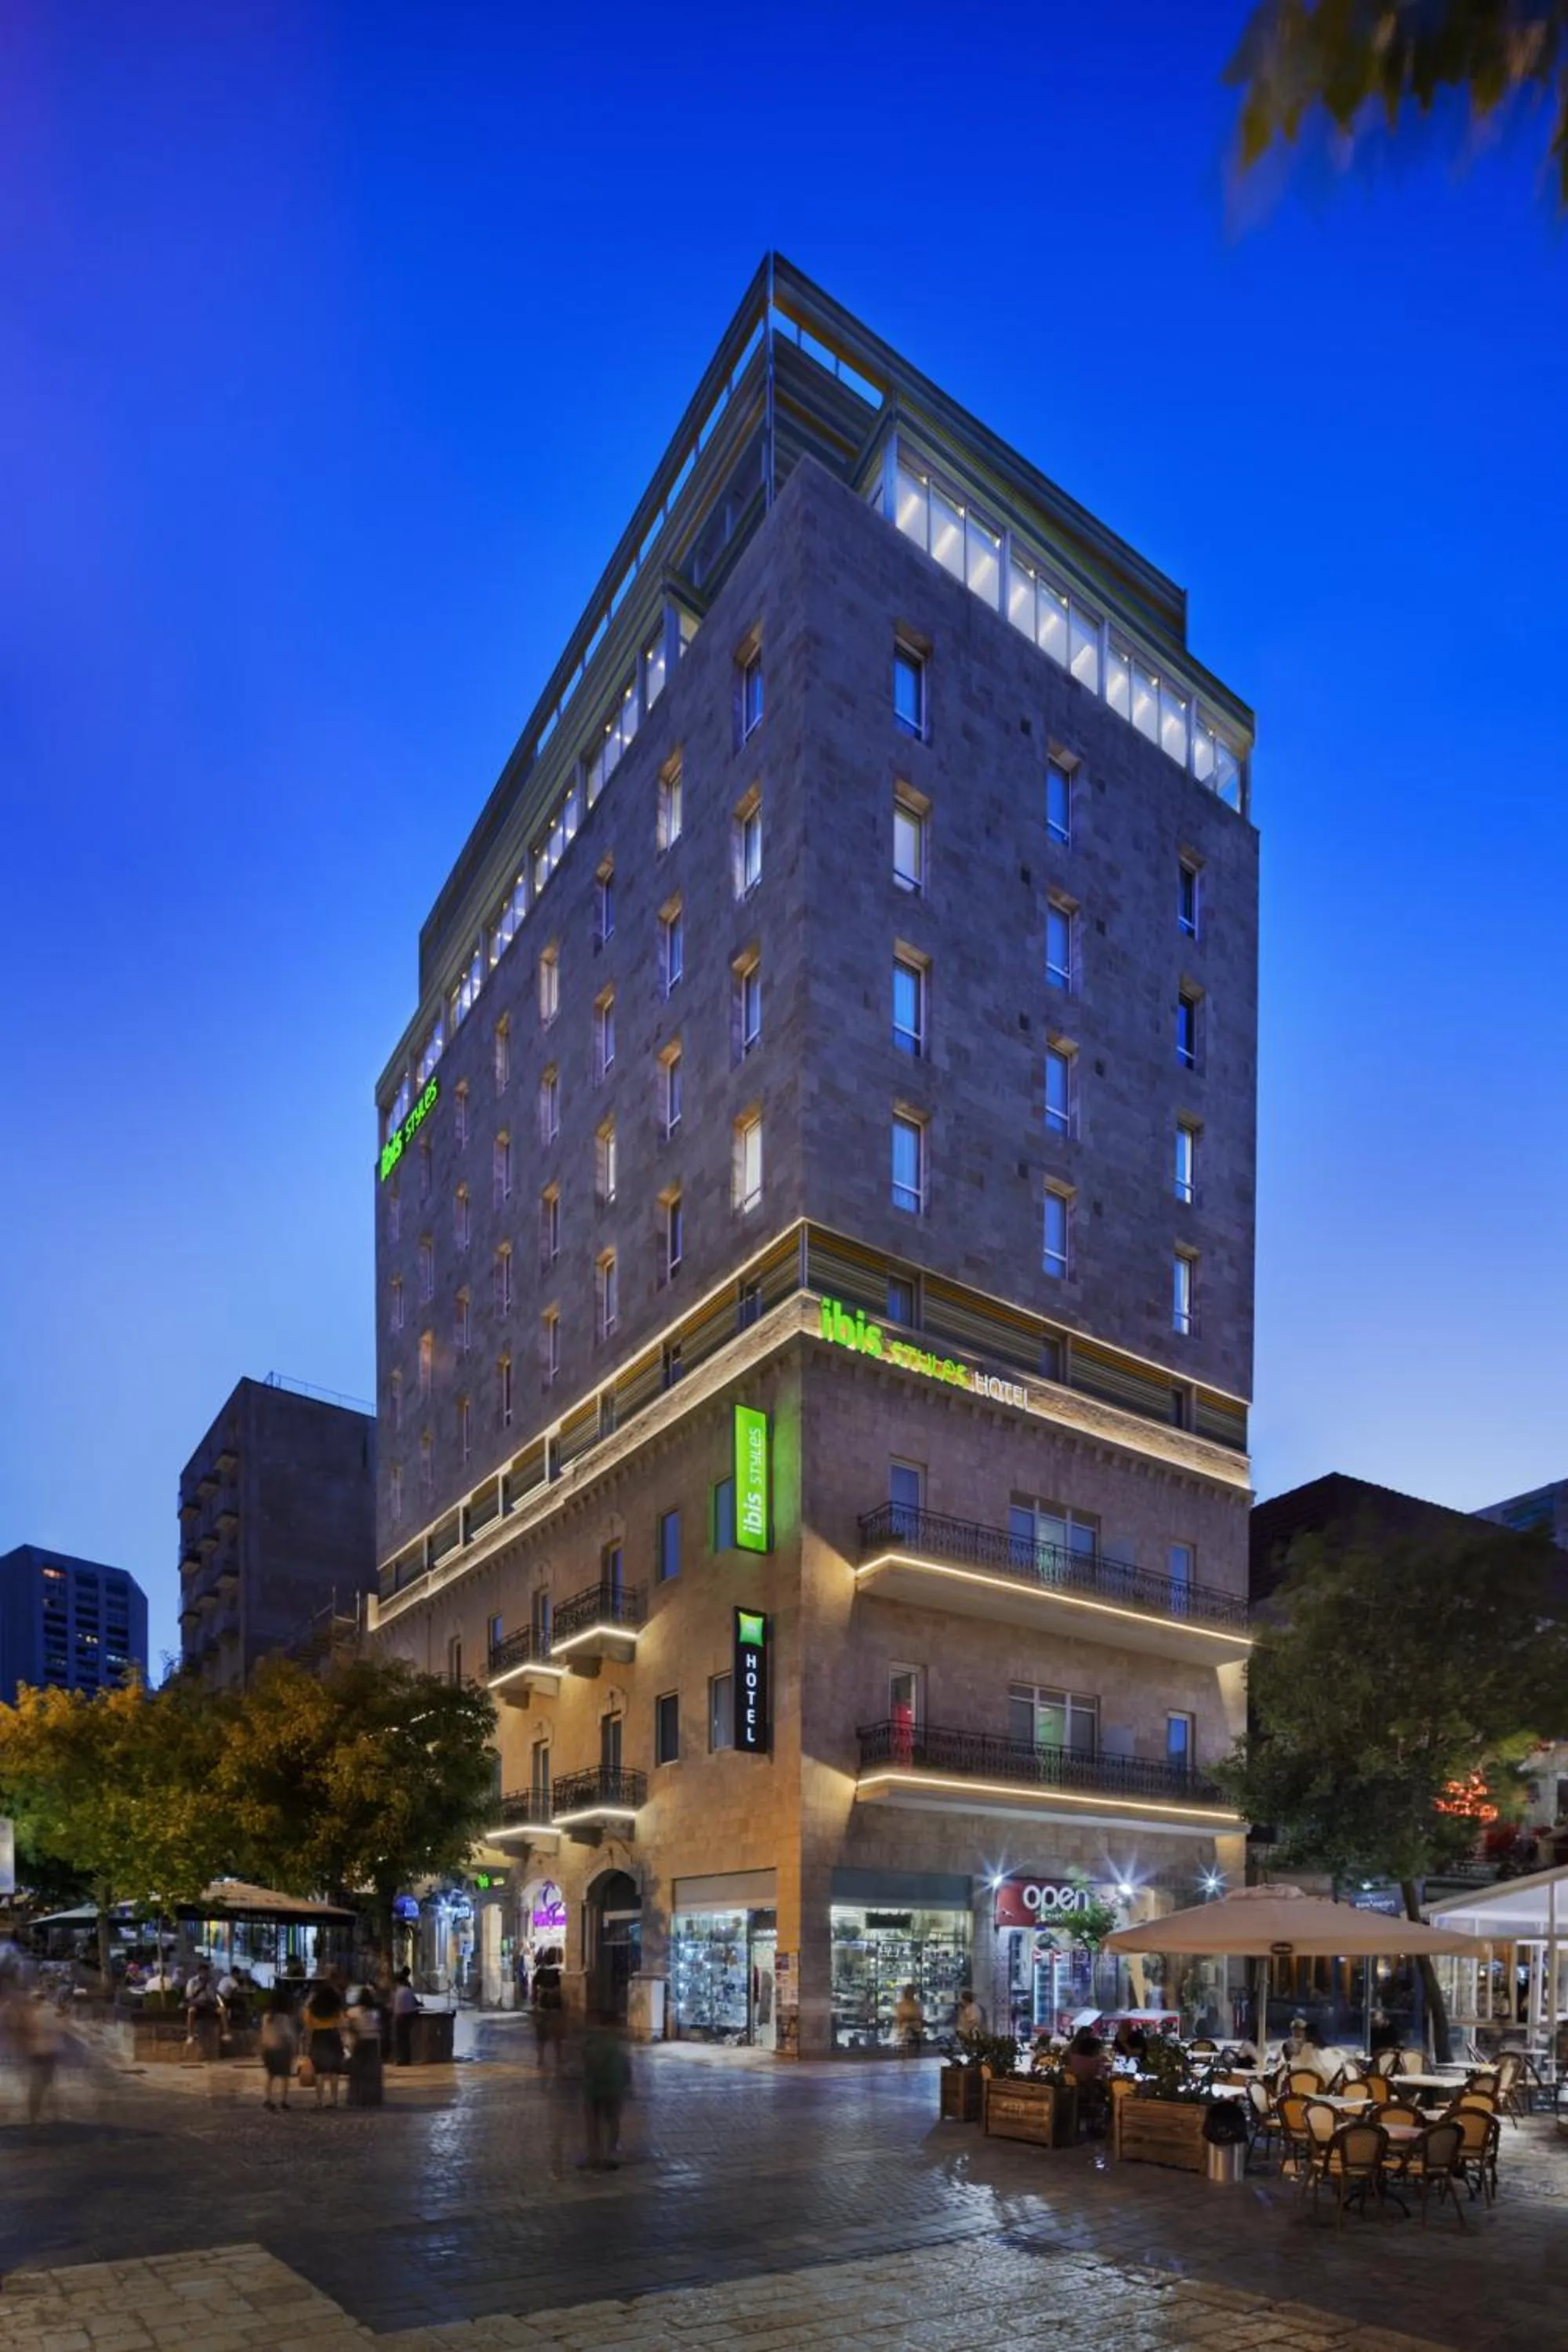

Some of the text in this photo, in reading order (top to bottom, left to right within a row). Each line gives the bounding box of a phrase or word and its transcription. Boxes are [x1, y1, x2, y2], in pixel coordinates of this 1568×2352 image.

[819, 1297, 882, 1357] ibis
[974, 1371, 1029, 1411] HOTEL
[742, 1492, 763, 1535] ibis
[746, 1653, 757, 1743] HOTEL
[1022, 1884, 1090, 1920] open
